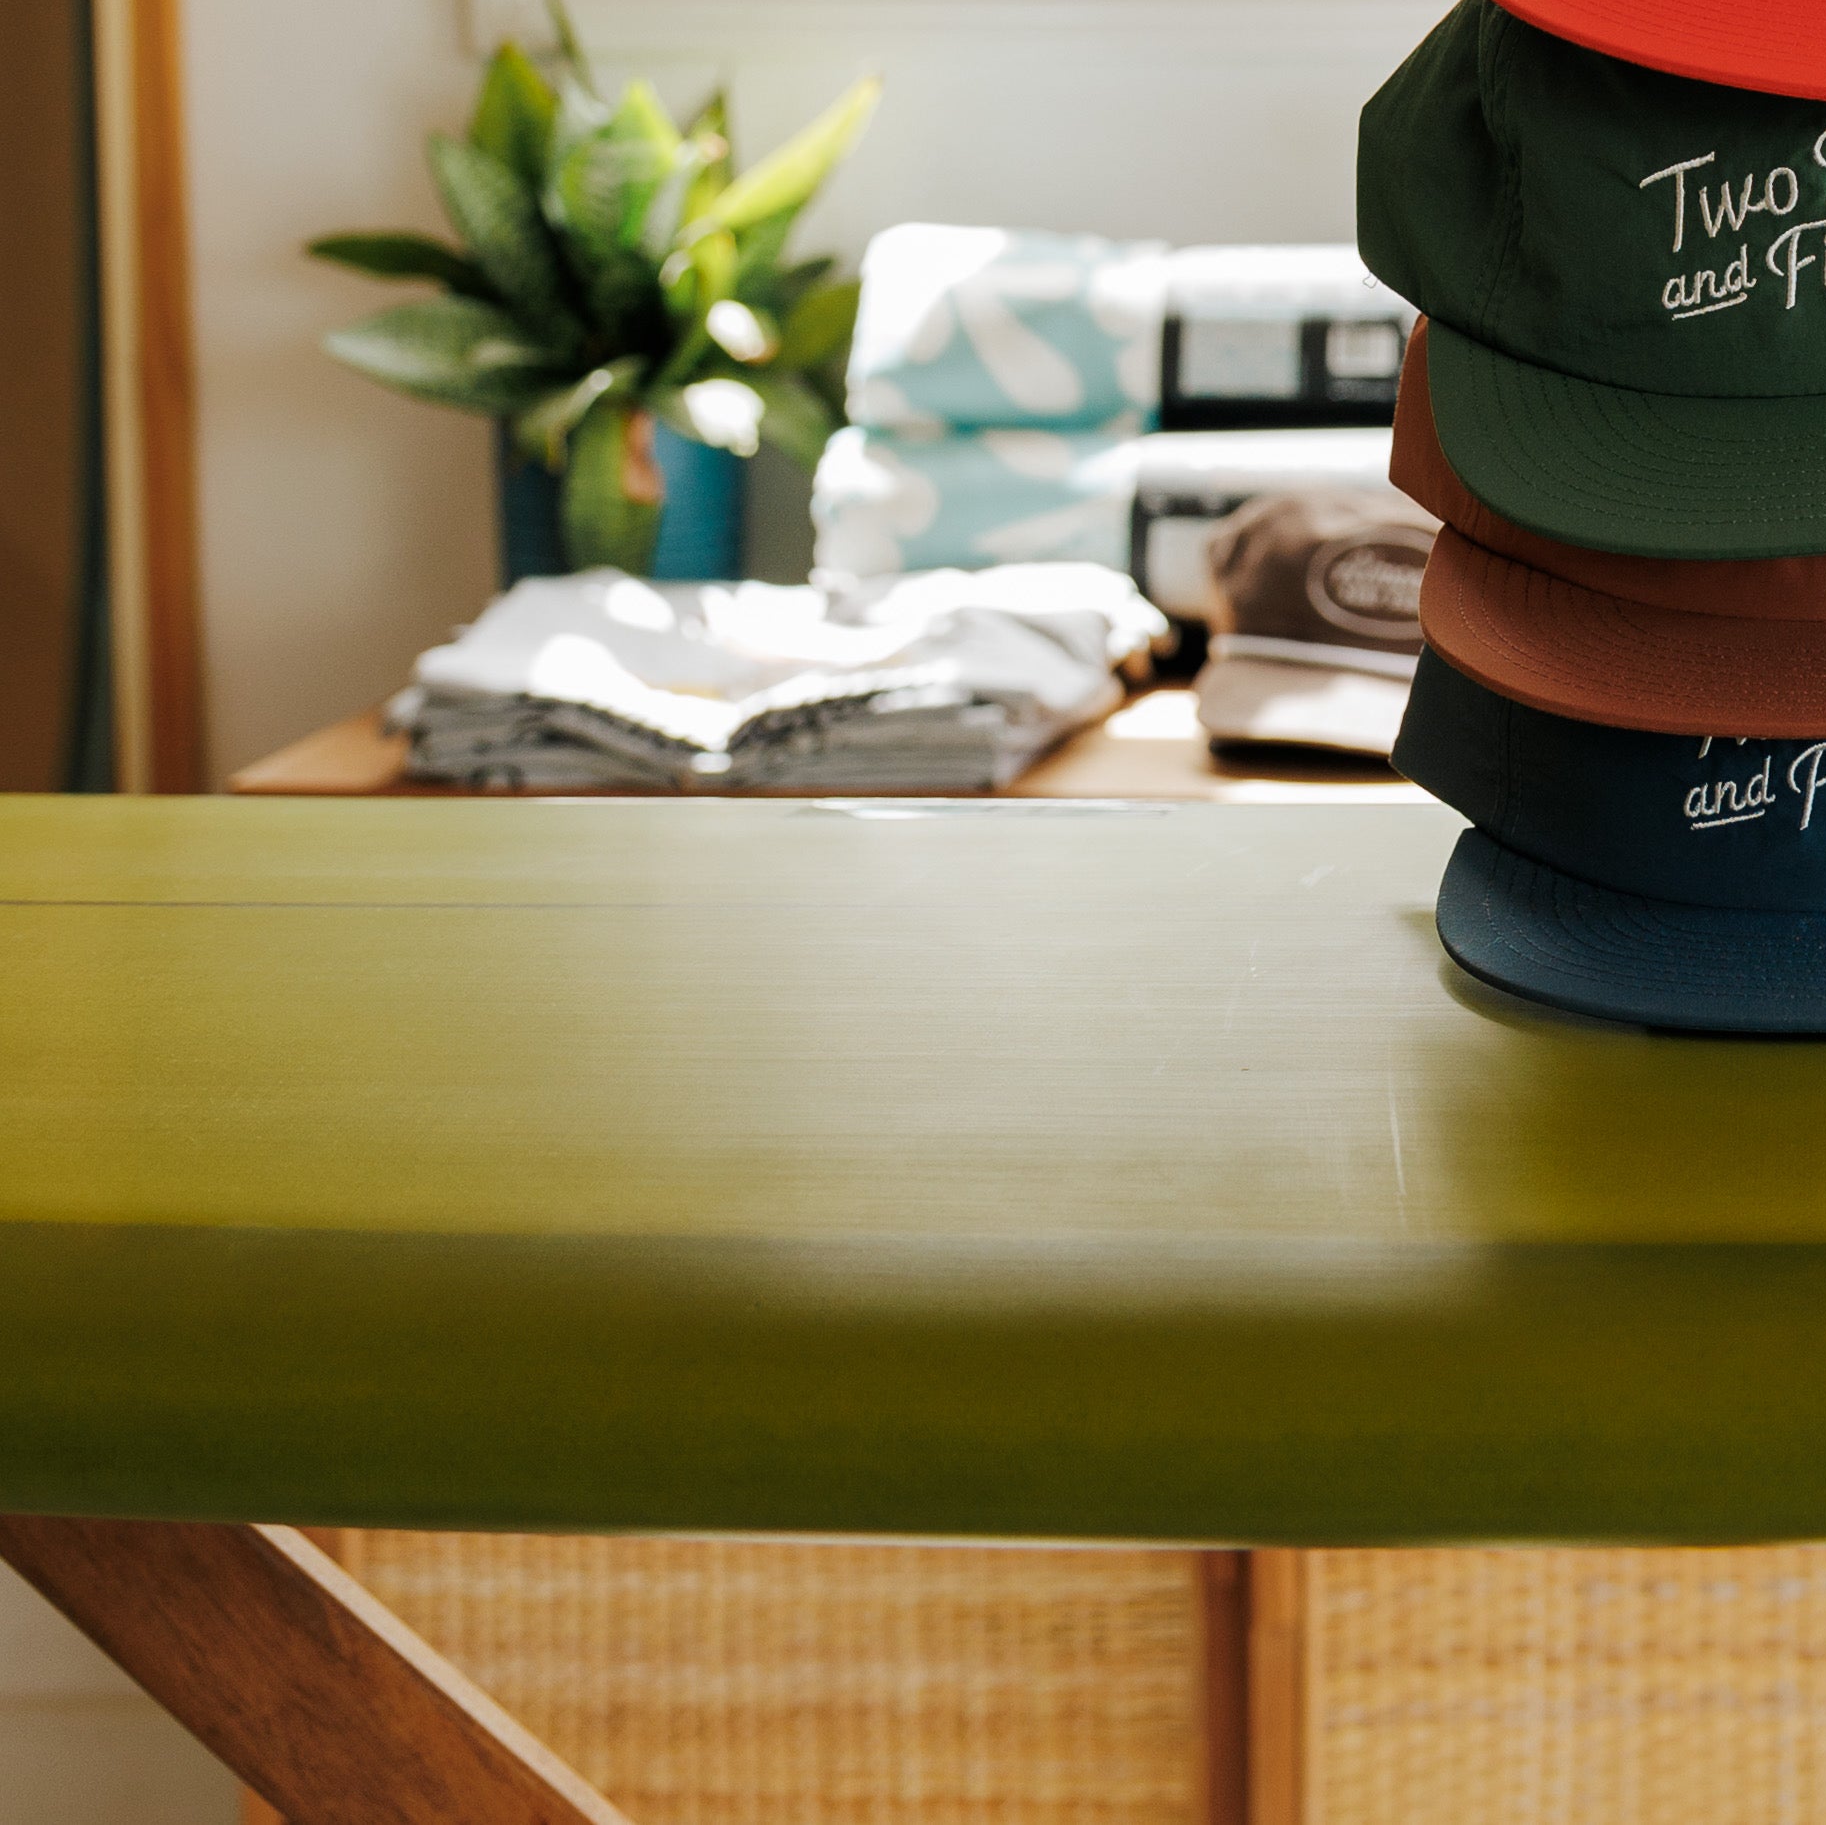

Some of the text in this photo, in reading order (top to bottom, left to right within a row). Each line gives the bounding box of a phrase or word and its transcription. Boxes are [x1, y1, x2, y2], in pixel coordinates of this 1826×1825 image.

[1639, 150, 1799, 253] Two
[1661, 242, 1758, 311] and
[1683, 755, 1776, 821] and
